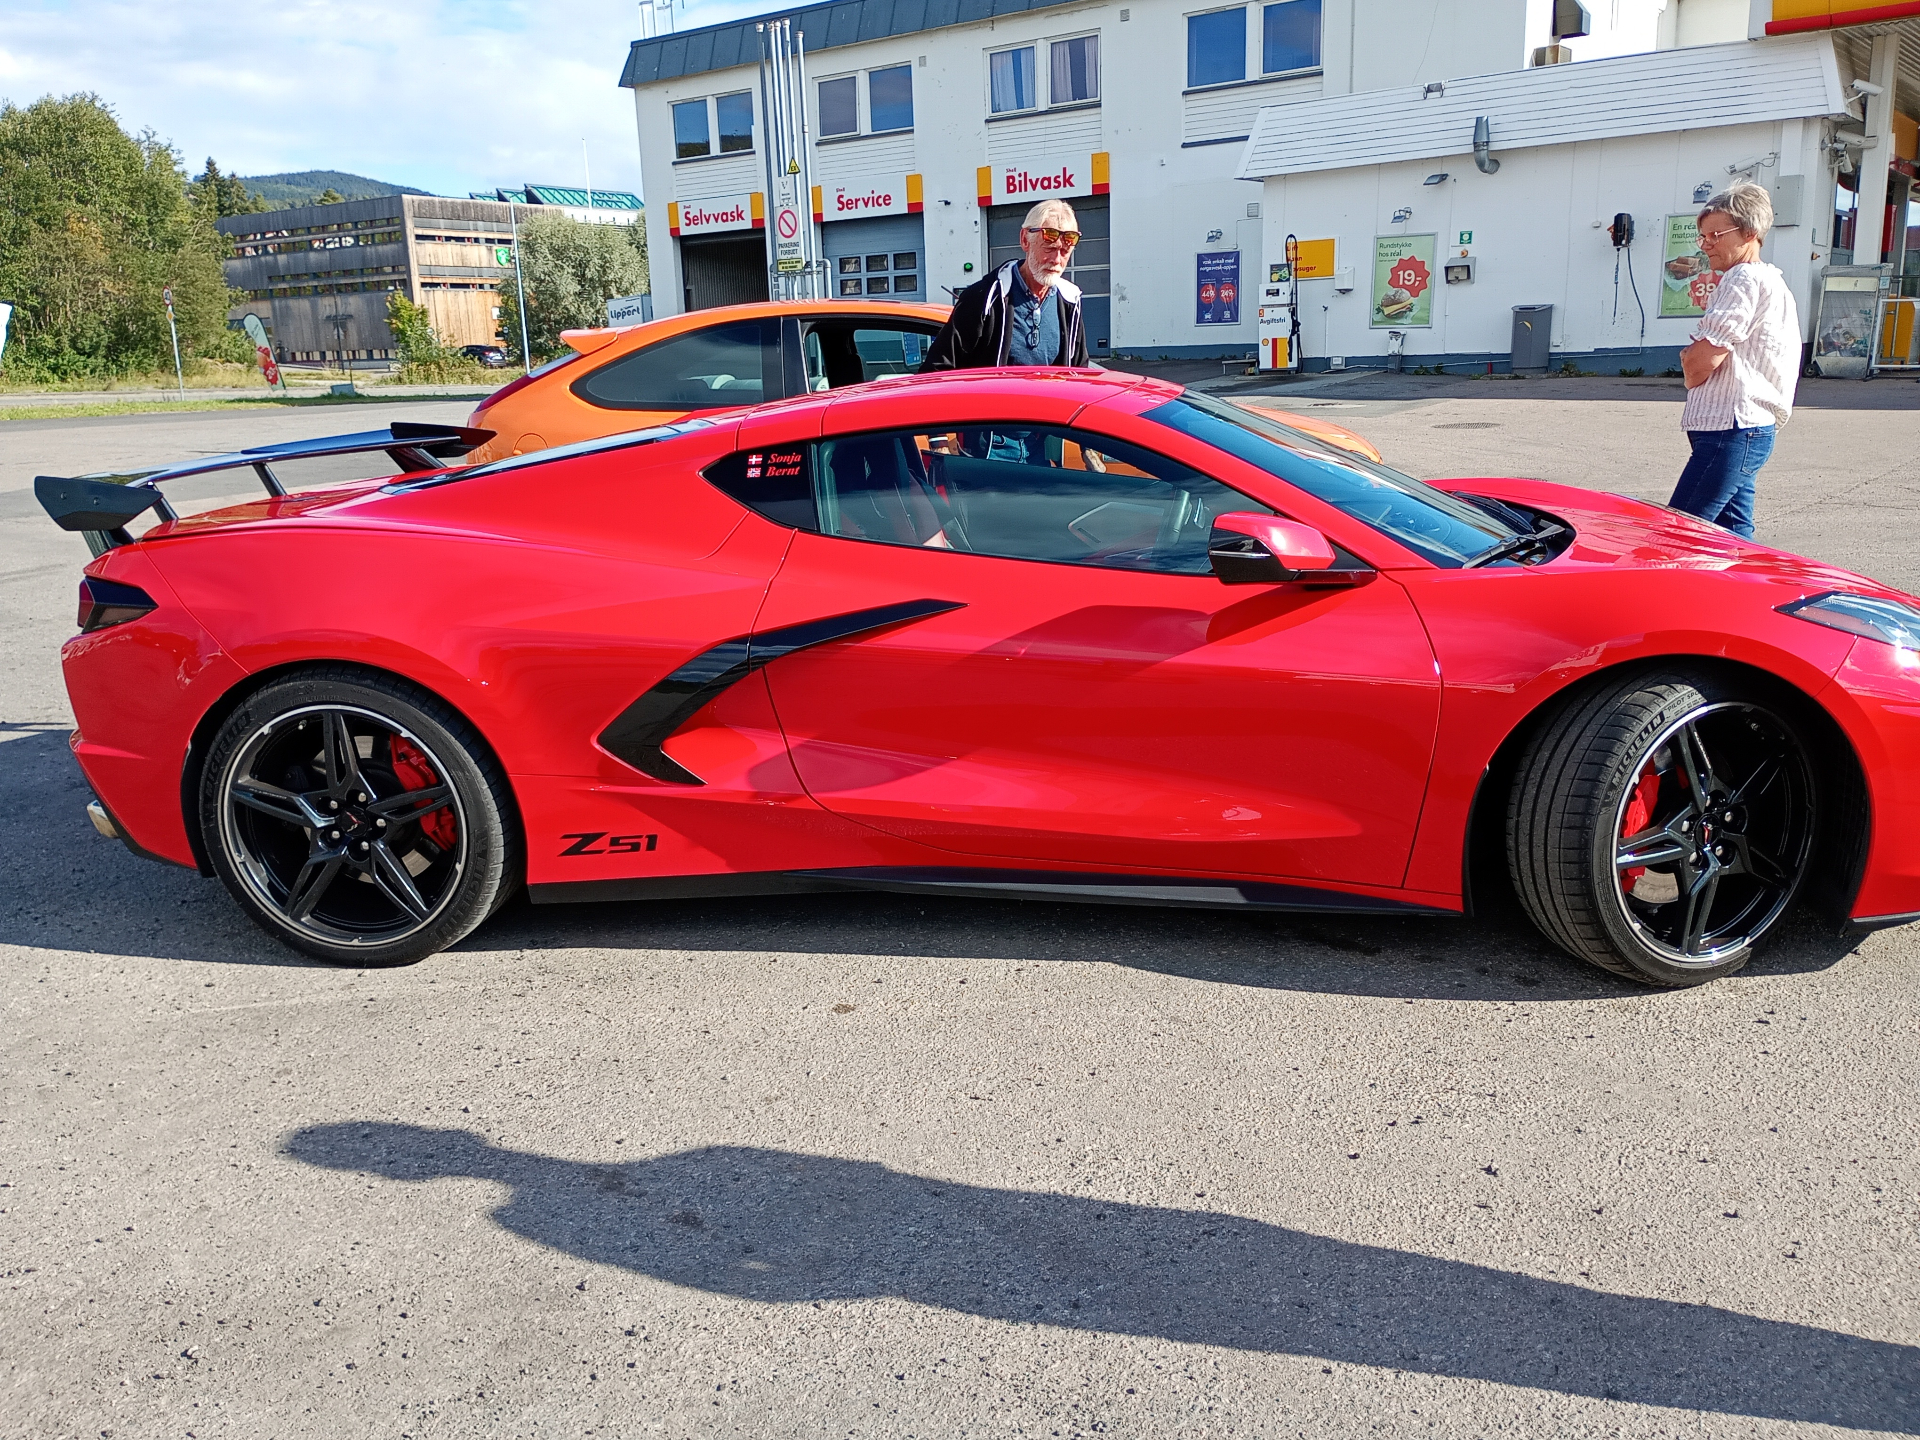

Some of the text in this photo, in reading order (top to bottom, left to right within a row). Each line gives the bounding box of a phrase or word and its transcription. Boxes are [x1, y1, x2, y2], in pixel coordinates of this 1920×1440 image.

[1006, 167, 1075, 194] Bilvask
[837, 189, 892, 211] Service
[684, 204, 745, 227] Selvvask
[1672, 222, 1697, 231] En réa
[1672, 232, 1698, 240] matpak
[1397, 269, 1422, 287] 19,-
[1260, 317, 1285, 325] Avgiftsfri
[768, 453, 801, 465] Sonja
[766, 466, 800, 477] Bernt
[1667, 697, 1685, 712] PILOT
[1612, 711, 1664, 787] MICHELIN
[557, 832, 658, 857] Z51
